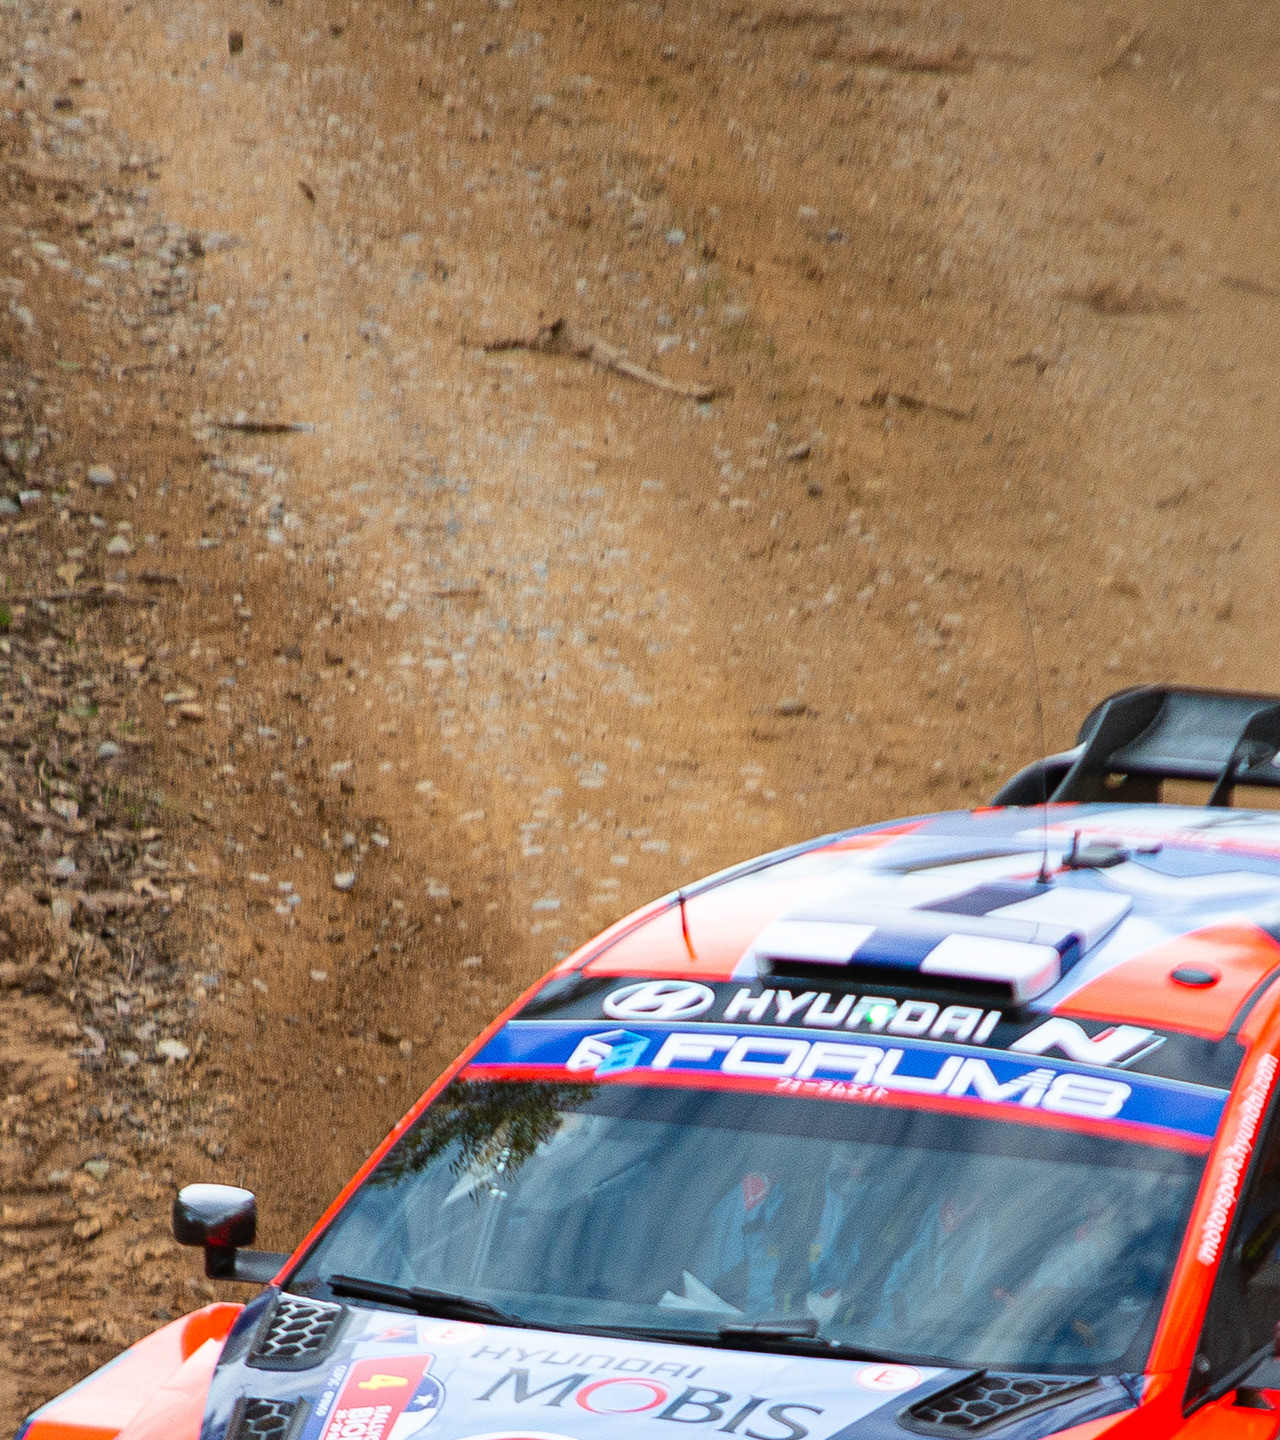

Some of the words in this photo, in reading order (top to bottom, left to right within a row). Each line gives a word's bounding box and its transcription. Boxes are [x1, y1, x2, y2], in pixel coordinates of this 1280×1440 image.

[722, 987, 1002, 1041] HYUNDAI
[651, 1033, 1132, 1119] FORUM8
[1197, 1053, 1278, 1266] motorsport.hyundai.com
[358, 1374, 408, 1390] 4
[470, 1345, 707, 1379] HYUNDAI
